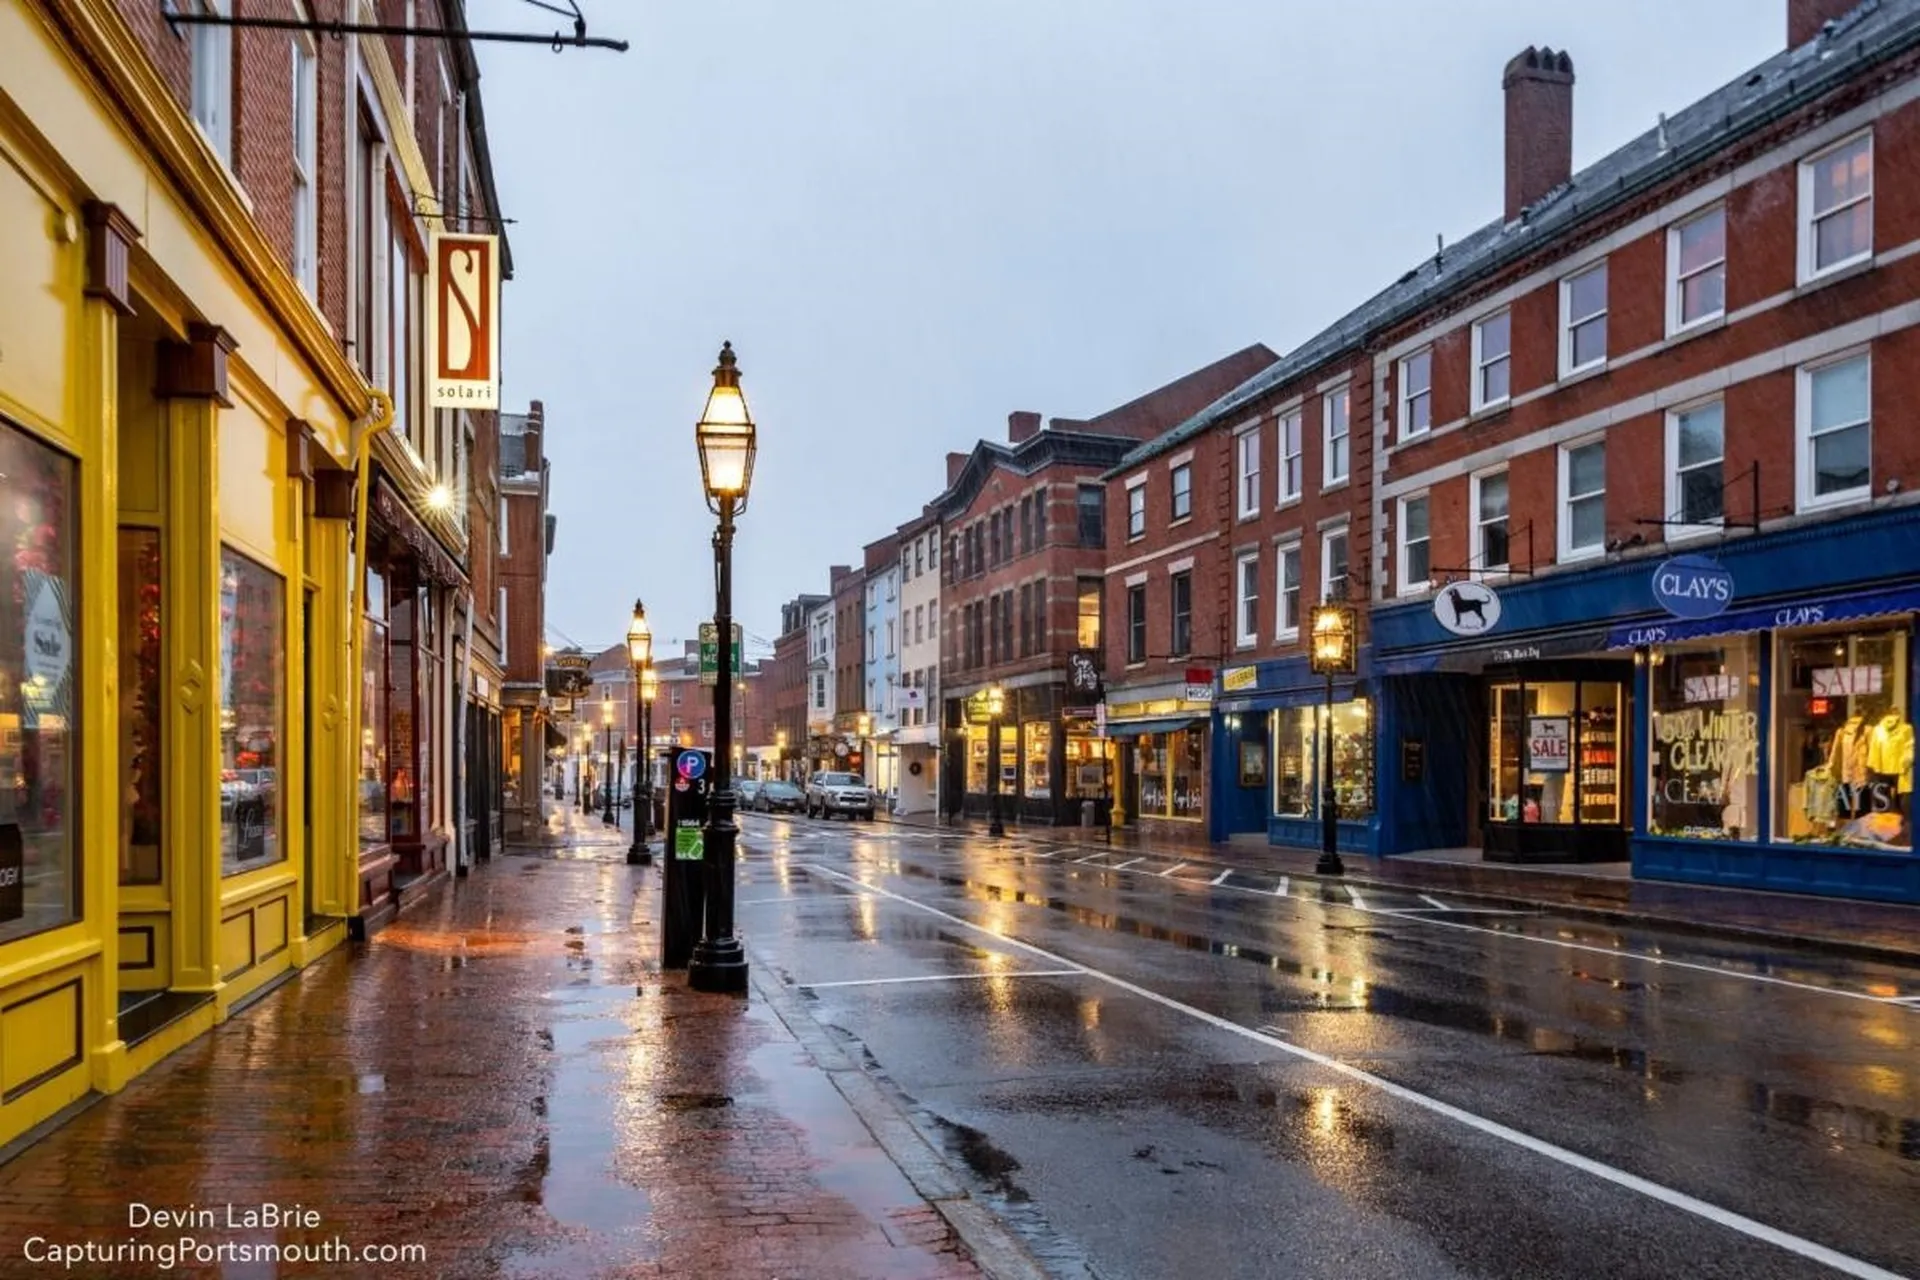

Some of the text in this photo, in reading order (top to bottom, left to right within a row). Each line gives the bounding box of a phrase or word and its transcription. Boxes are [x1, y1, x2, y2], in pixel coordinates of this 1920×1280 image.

[437, 385, 492, 399] solari
[1659, 573, 1729, 601] CLAY'S
[1684, 675, 1740, 701] SALE
[1812, 665, 1882, 695] SALE
[1532, 739, 1567, 757] SALE
